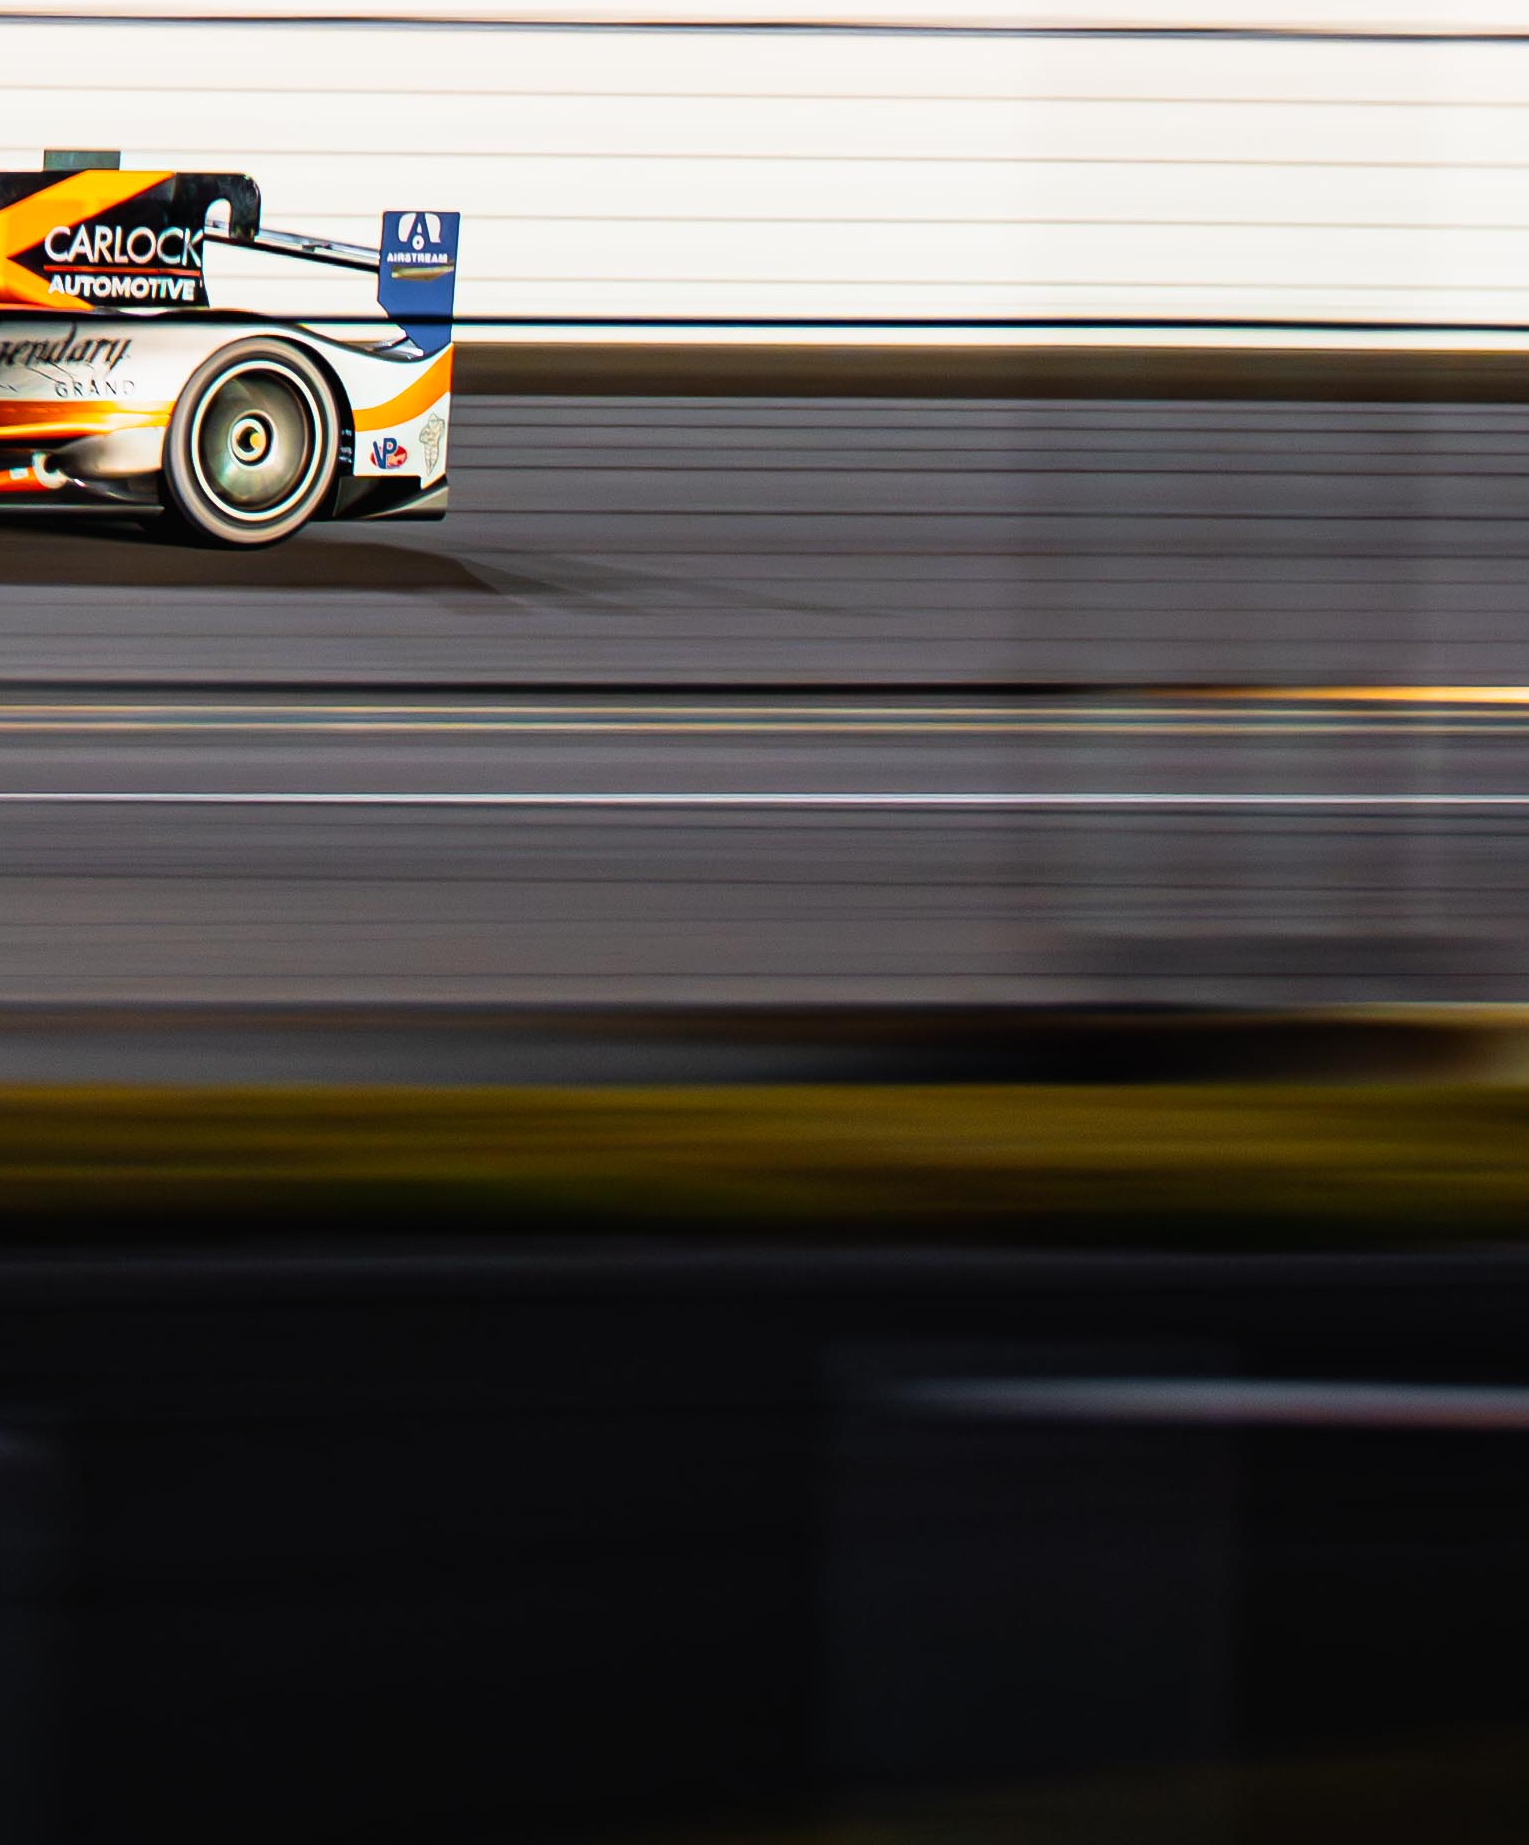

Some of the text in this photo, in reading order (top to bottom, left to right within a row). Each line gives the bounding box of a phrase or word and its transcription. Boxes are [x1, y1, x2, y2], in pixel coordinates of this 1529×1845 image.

[44, 225, 204, 267] CARLOCK
[387, 252, 448, 264] AIRSTREAM
[48, 274, 196, 301] AUTOMOTIVE
[55, 379, 135, 398] GRAND
[372, 437, 398, 469] VP
